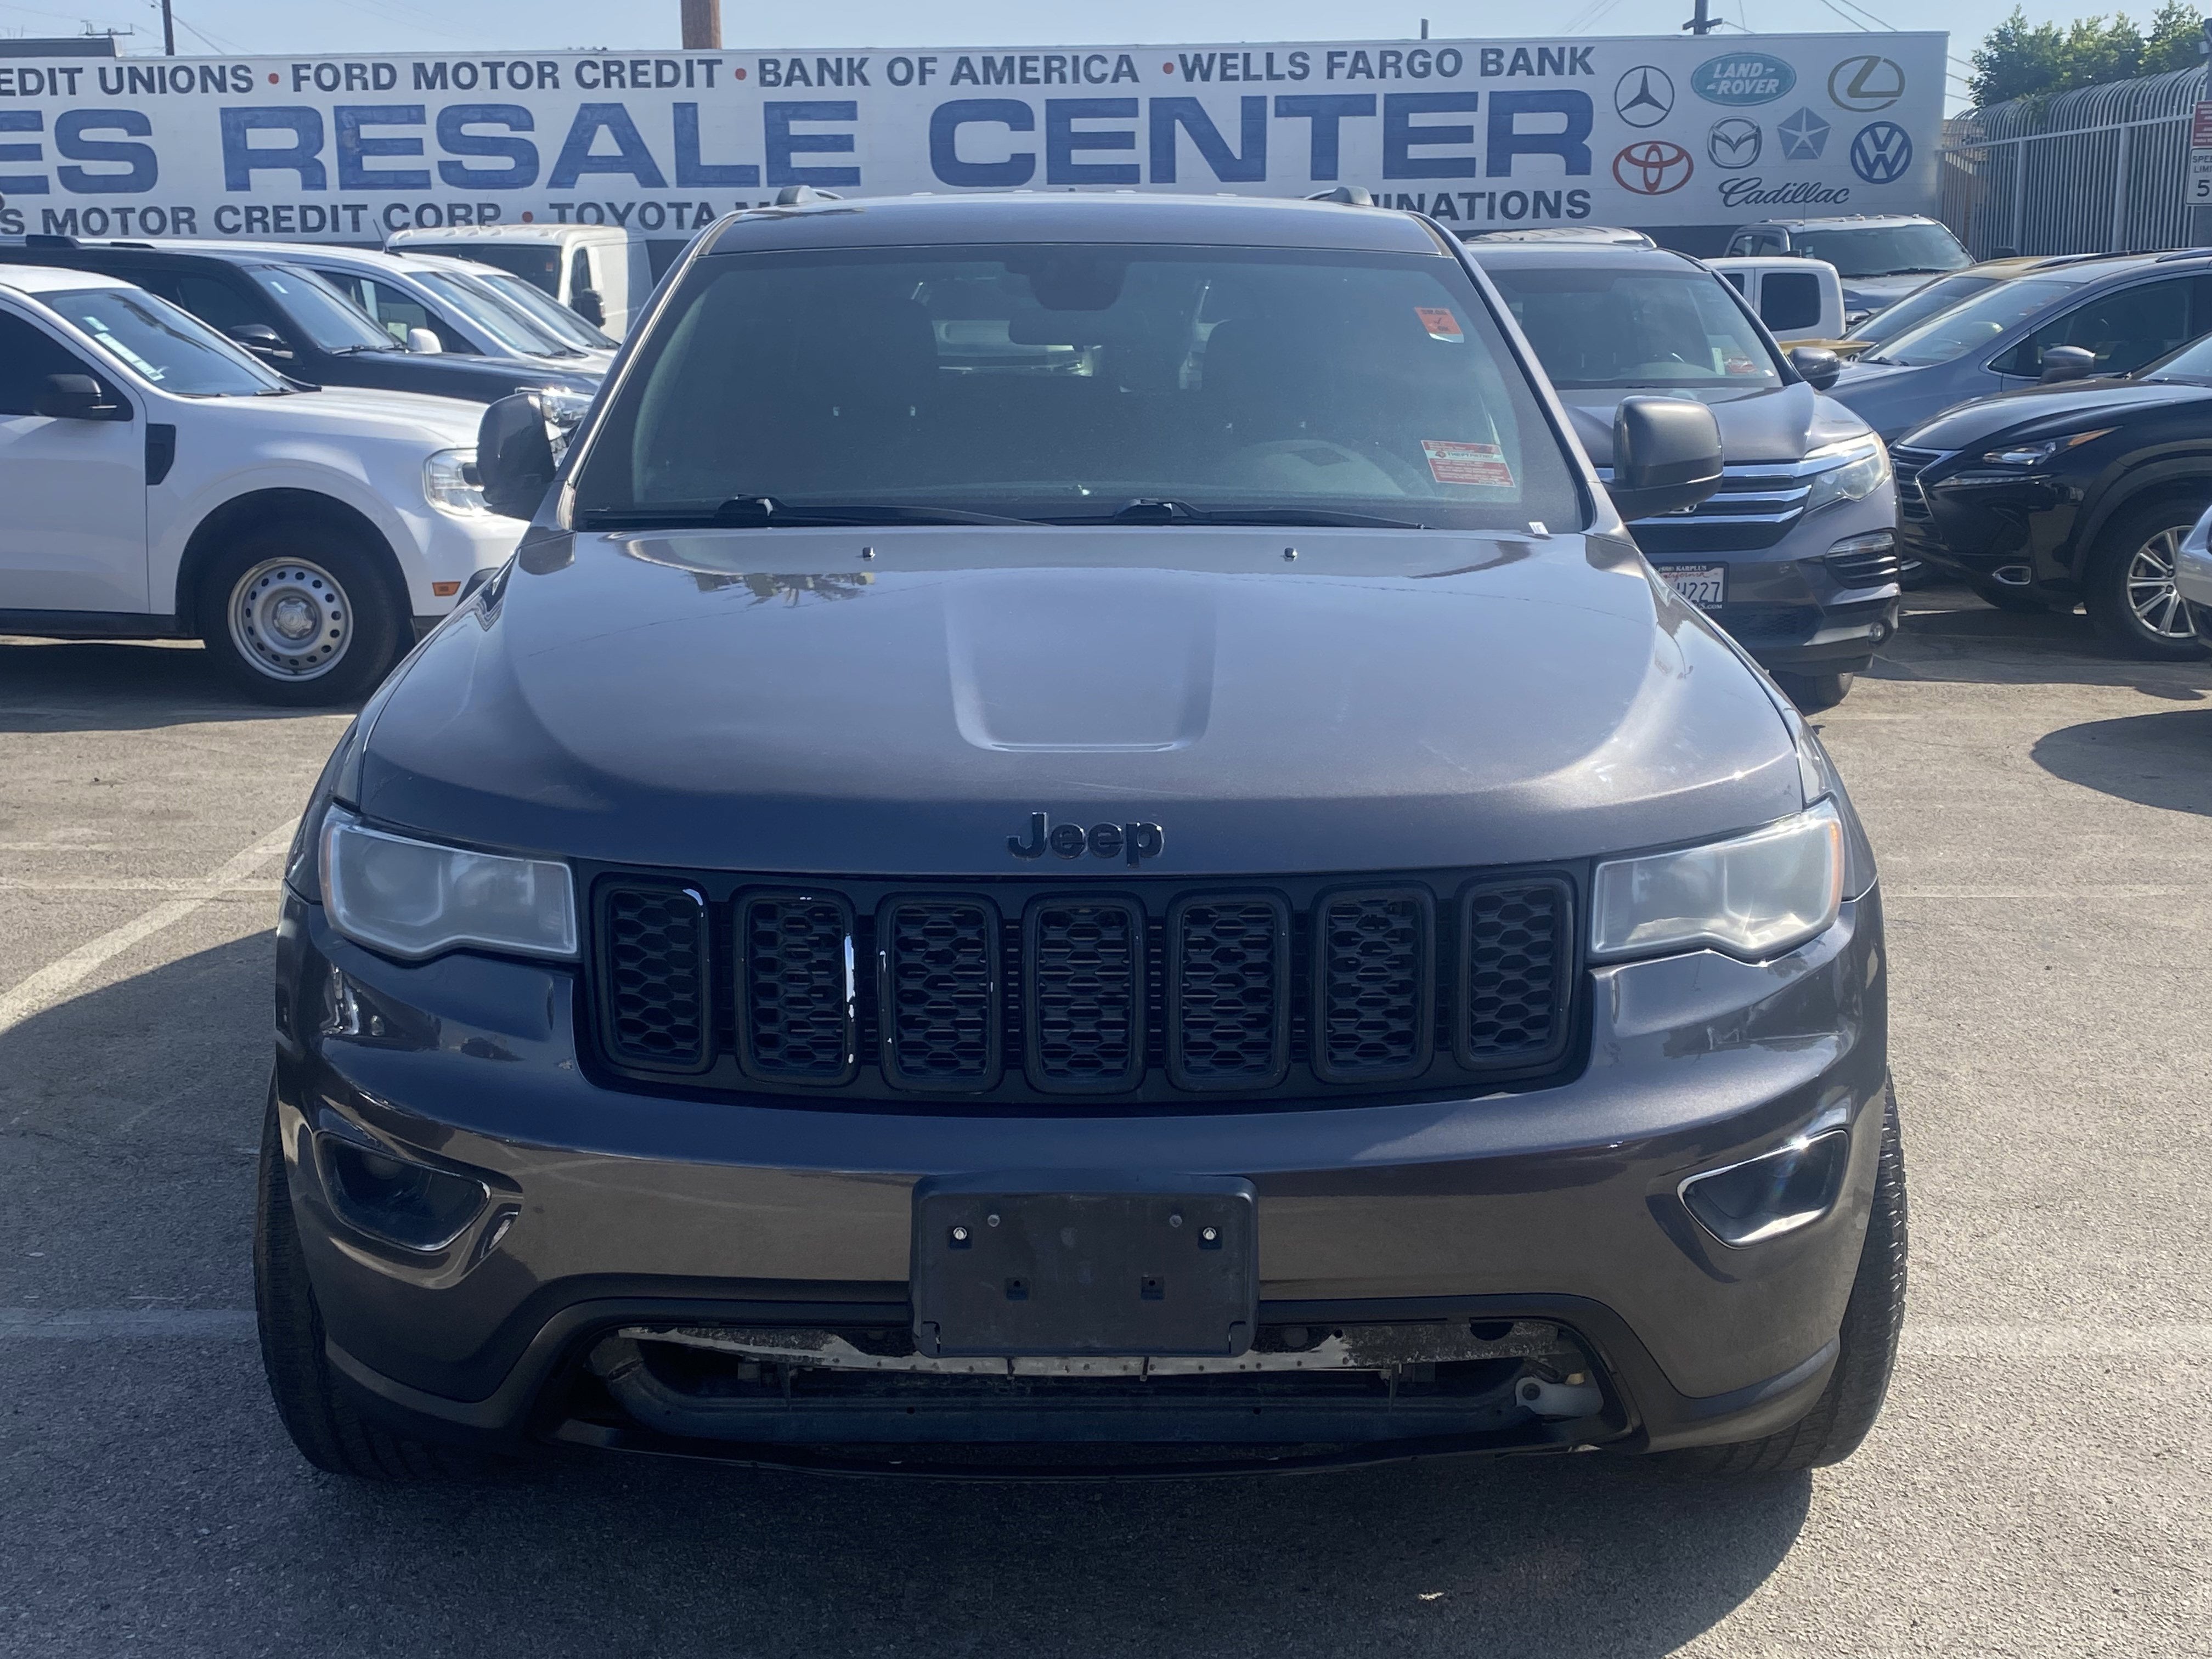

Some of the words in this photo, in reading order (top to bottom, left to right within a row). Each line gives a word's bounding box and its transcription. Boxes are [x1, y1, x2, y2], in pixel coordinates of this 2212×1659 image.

[98, 64, 253, 95] UNIONS
[292, 62, 397, 92] FORD
[414, 60, 560, 91] MOTOR
[575, 59, 723, 89] CREDIT
[759, 57, 870, 87] BANK
[886, 57, 938, 86] OF
[950, 54, 1139, 86] AMERICA
[1178, 51, 1310, 82] WELLS
[1326, 48, 1463, 80] FARGO
[1480, 46, 1595, 77] BANK
[219, 100, 861, 191] RESALE
[930, 89, 1594, 187] CENTER
[1718, 177, 1849, 207] Cadillac
[2197, 180, 2210, 196] 5
[42, 206, 196, 236] MOTOR
[214, 203, 368, 235] CREDIT
[549, 201, 718, 230] TOYOTA
[1007, 811, 1165, 868] Jeep
